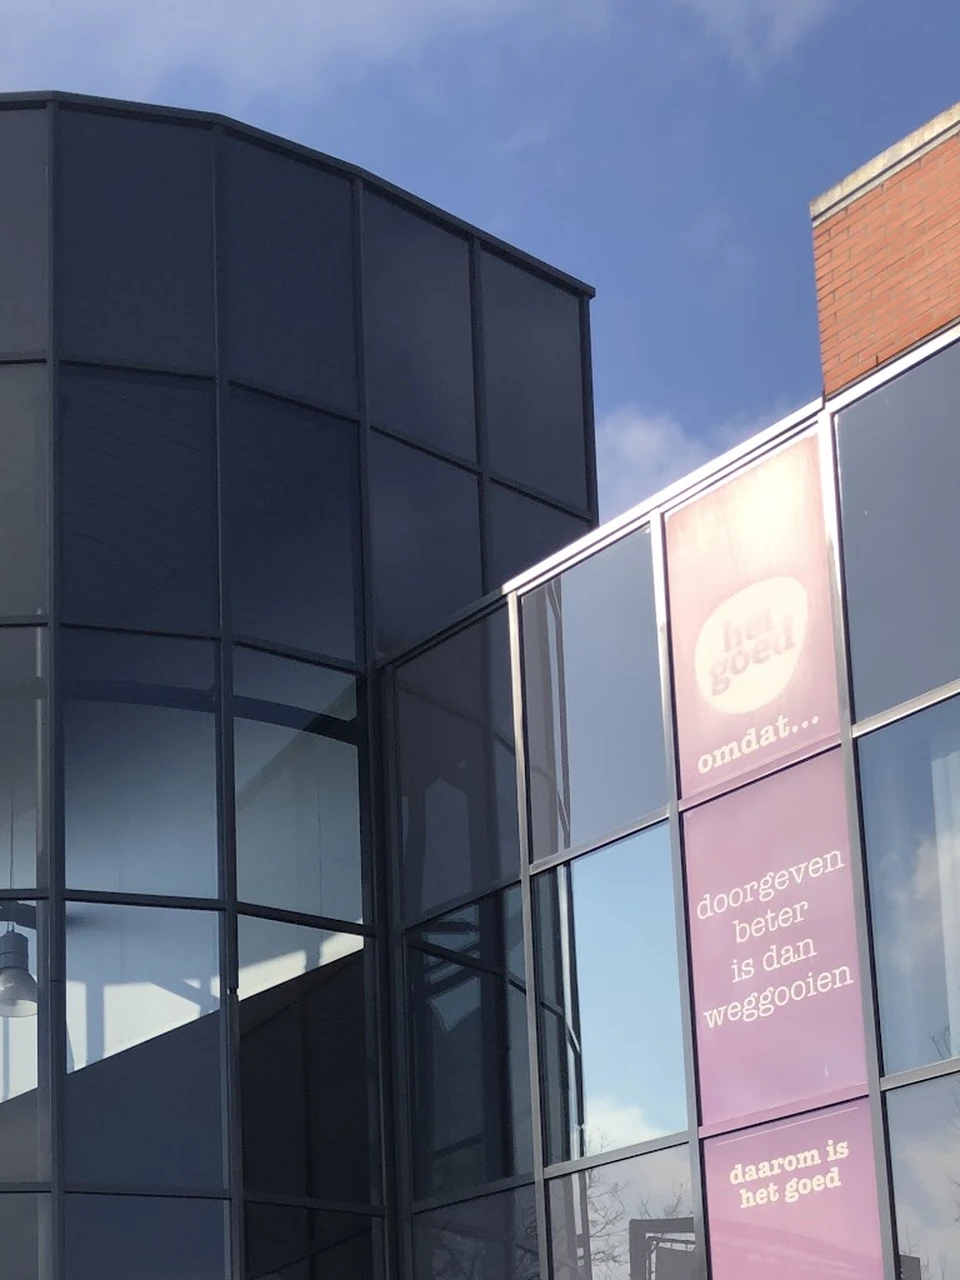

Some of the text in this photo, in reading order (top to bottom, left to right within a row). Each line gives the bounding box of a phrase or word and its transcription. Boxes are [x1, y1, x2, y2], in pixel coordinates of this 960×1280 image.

[709, 615, 795, 696] goed
[697, 714, 820, 774] omdat...
[696, 849, 845, 920] doorgeven
[732, 900, 809, 944] beter
[731, 938, 818, 983] is dan
[702, 964, 855, 1029] weggooien
[729, 1139, 850, 1185] daarom is
[739, 1166, 842, 1208] het goed
